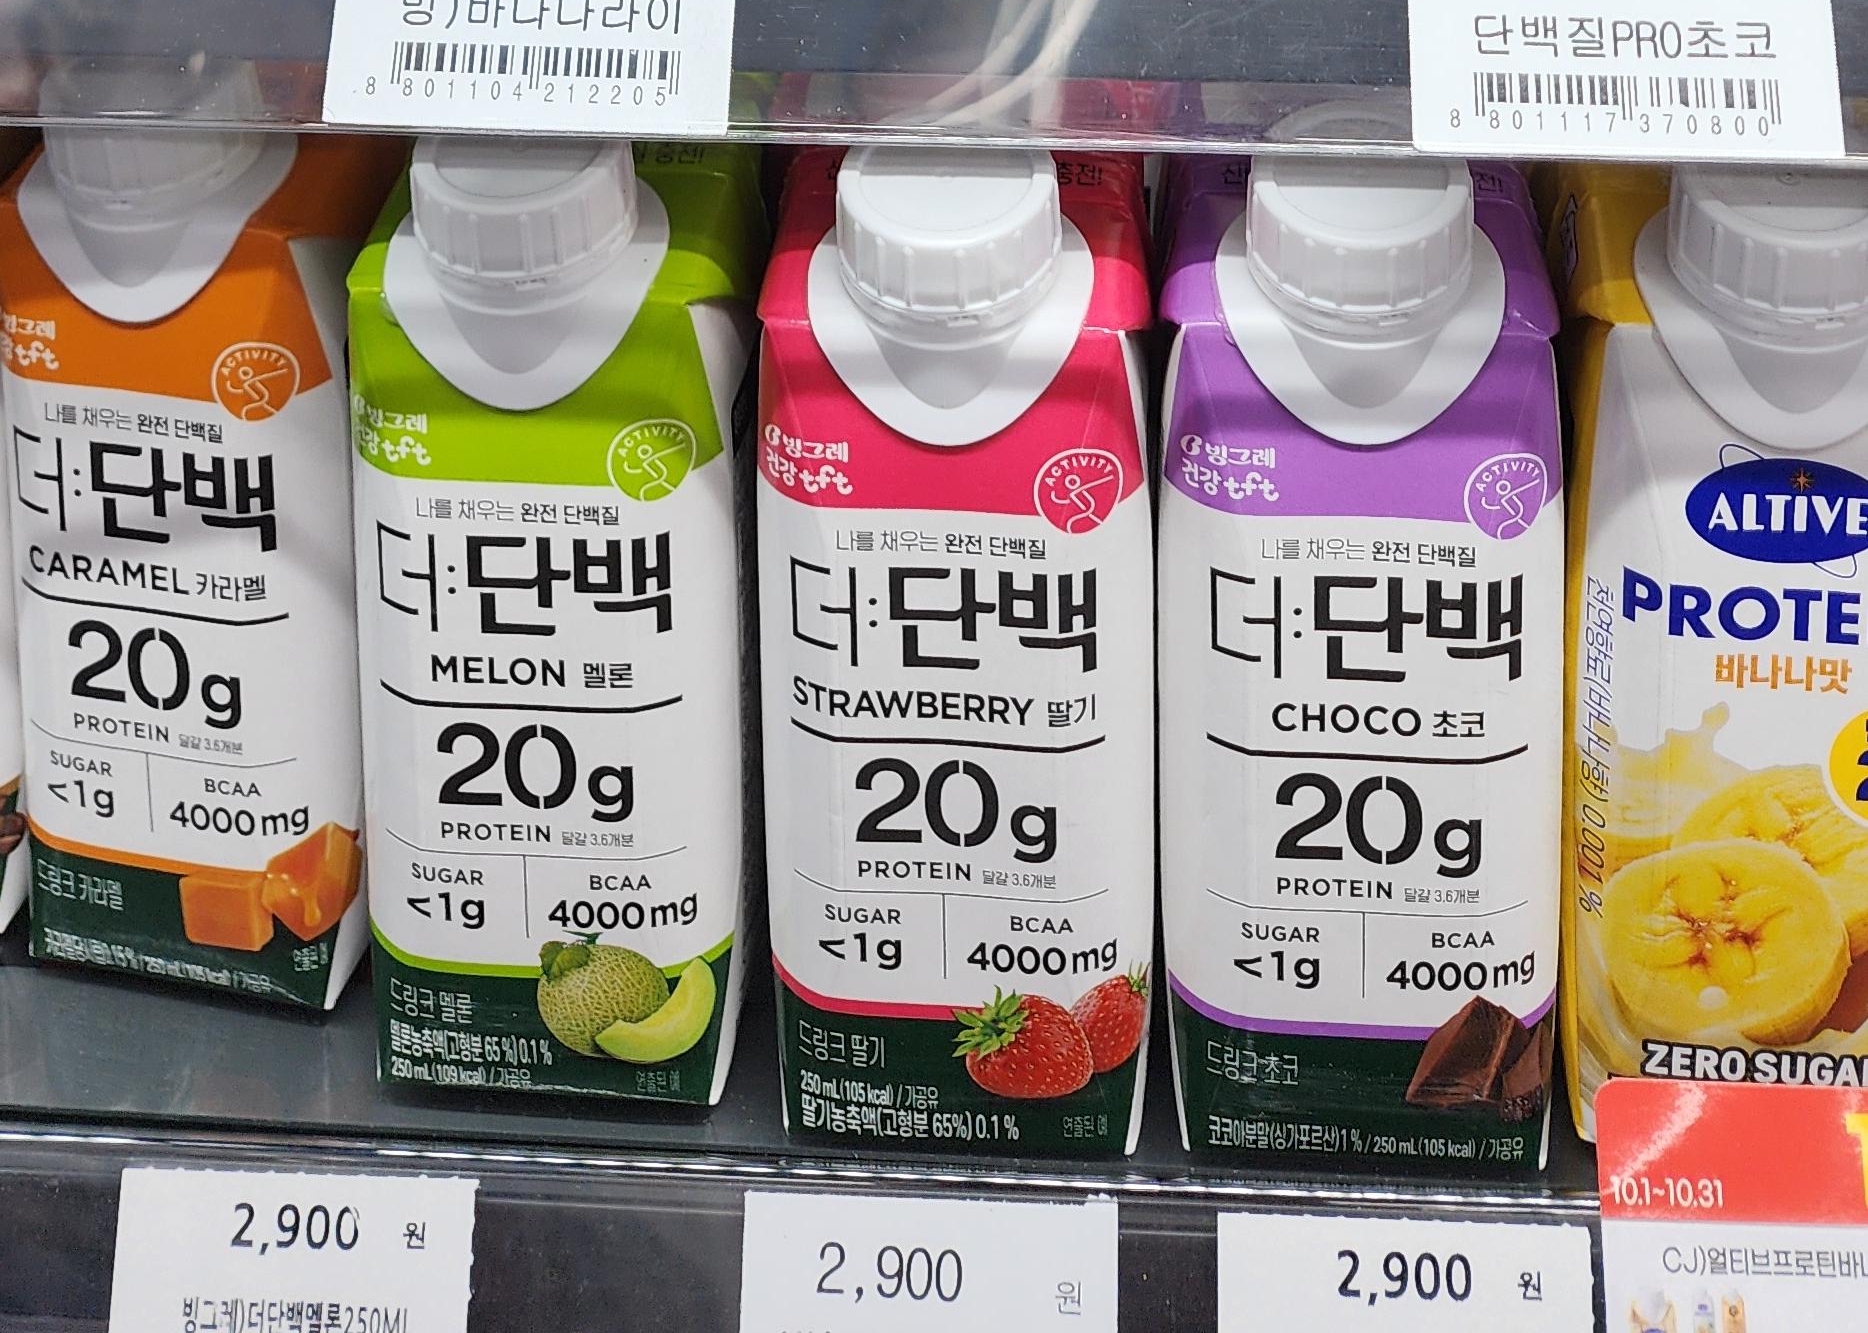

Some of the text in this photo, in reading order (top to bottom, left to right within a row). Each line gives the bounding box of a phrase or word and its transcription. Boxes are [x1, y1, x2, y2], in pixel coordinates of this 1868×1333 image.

[1473, 13, 1778, 60] 단백질PRO초코
[44, 402, 224, 445] 나를 채우는 완전 단백질
[784, 433, 849, 464] 빙그레
[1204, 442, 1276, 470] 빙그레
[800, 464, 853, 495] tft
[1223, 470, 1280, 502] tft
[416, 497, 620, 527] 나를 채우는 완전 단백질
[835, 529, 1047, 561] 나를 채우는 완전 단백질
[1261, 537, 1477, 568] 나를 채우는 완전 단백질
[29, 544, 267, 603] CARAMEL 카라멜
[430, 654, 634, 690] MELON 멜론
[1715, 653, 1853, 696] 바나나맛
[792, 674, 1098, 728] STRAWBERRY 딸기
[73, 711, 170, 744] PROTEIN
[1271, 702, 1486, 739] CHOCO 초코
[50, 749, 262, 799] SUGAR BCAA
[440, 820, 553, 844] PROTEIN
[411, 861, 652, 892] SUGAR BCAA
[857, 860, 973, 883] PROTEIN
[1276, 876, 1393, 900] PROTEIN
[824, 903, 1074, 934] SUGAR BCAA
[1240, 921, 1496, 949] SUGAR BCAA
[1643, 1040, 1745, 1081] ZERO
[1609, 1175, 1724, 1210] 10.1~10.31
[230, 1201, 427, 1257] 2,900 원
[816, 1239, 1082, 1316] 2,900 원
[1336, 1248, 1543, 1309] 2,900 원
